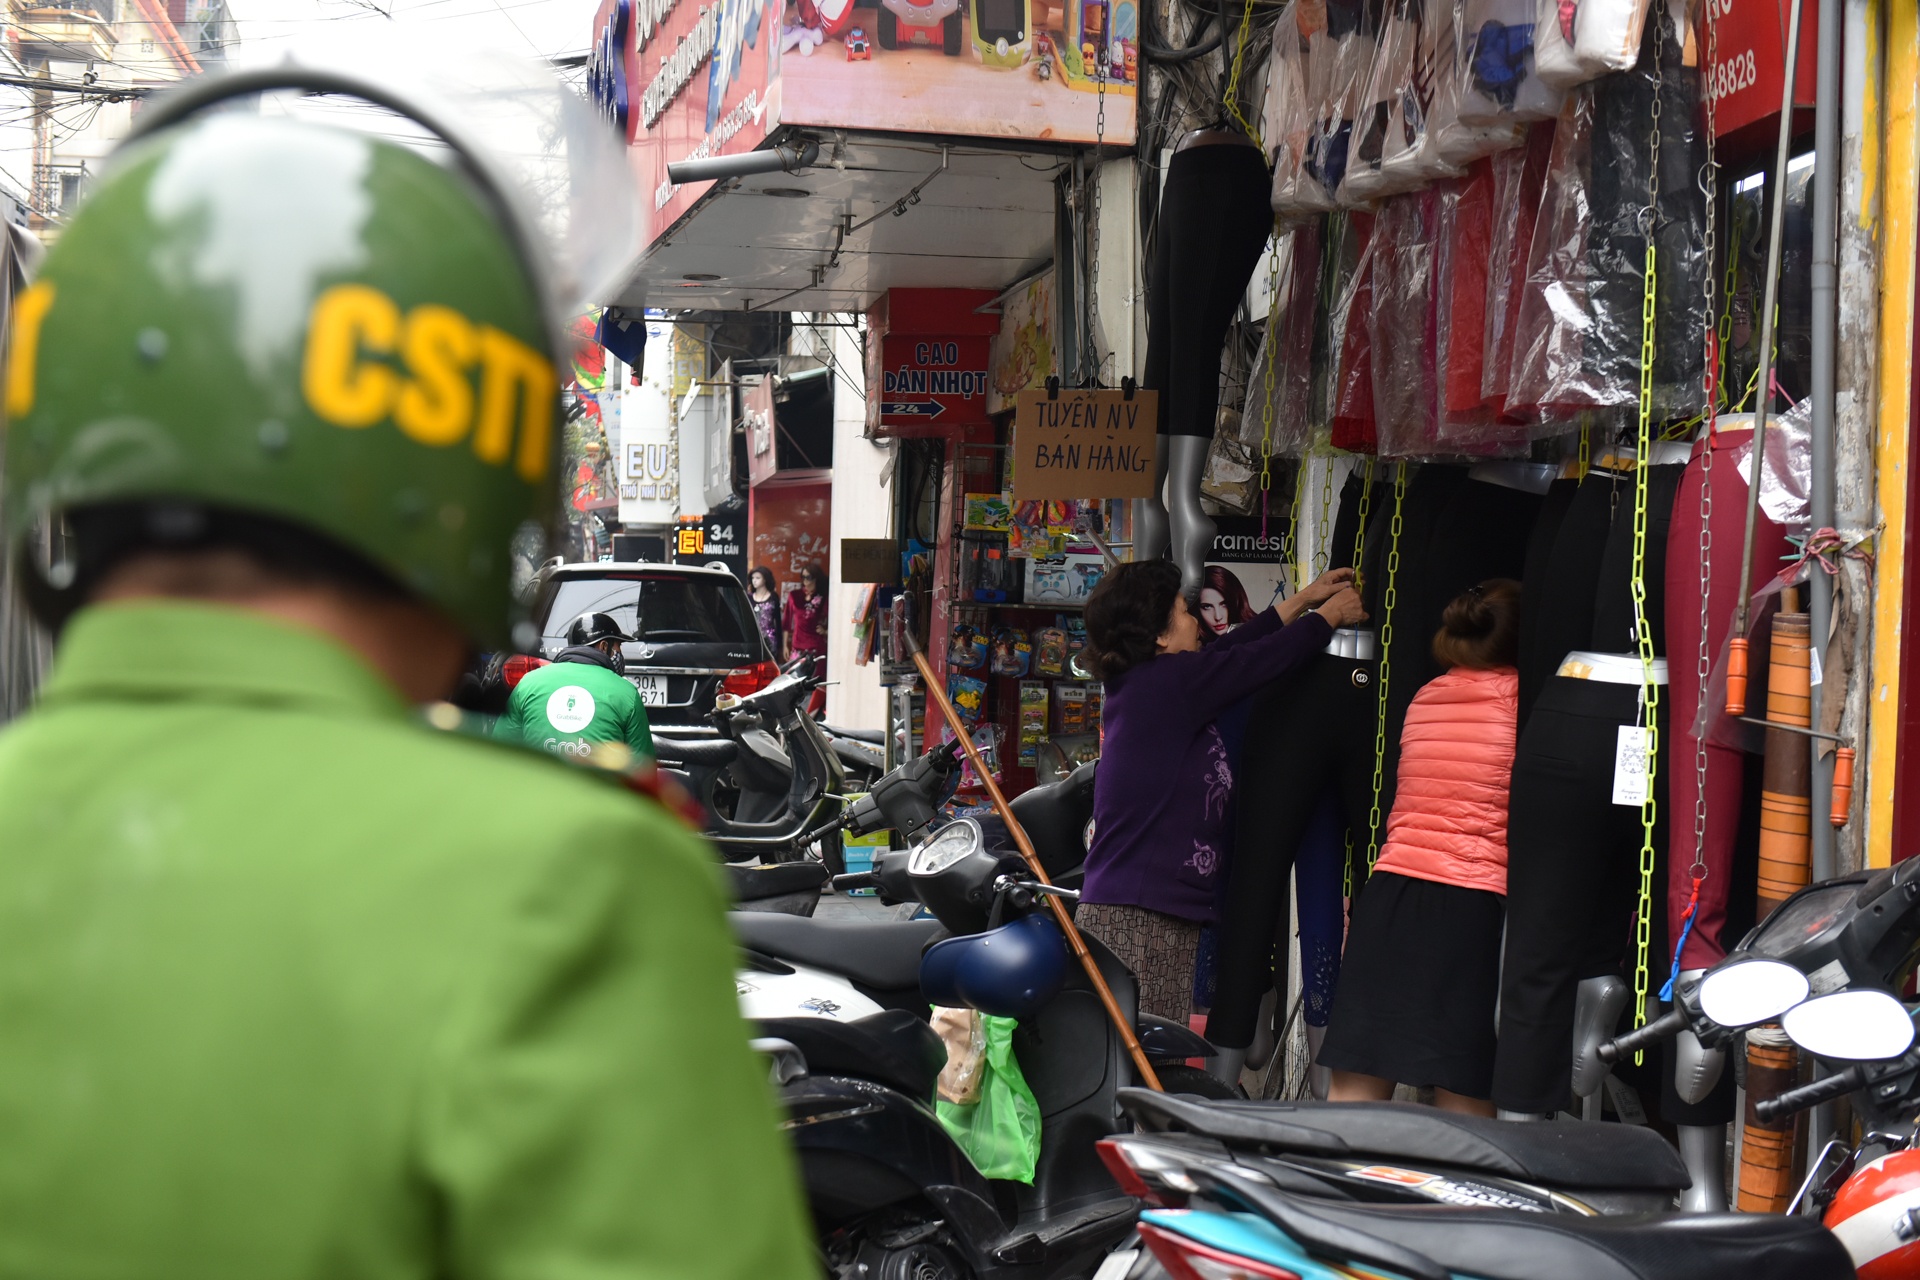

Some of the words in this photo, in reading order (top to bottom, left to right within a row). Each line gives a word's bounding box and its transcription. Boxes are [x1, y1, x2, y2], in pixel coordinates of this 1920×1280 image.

[915, 342, 958, 366] CAO
[677, 361, 703, 377] EU
[884, 364, 927, 394] DÁN
[929, 370, 987, 400] NHỌT
[892, 404, 919, 414] 24
[1107, 402, 1139, 429] NV
[626, 443, 668, 480] EU
[1035, 433, 1081, 470] BÁN
[1087, 434, 1151, 473] HÀNG
[710, 524, 734, 541] 34
[703, 541, 723, 555] HÀNG
[634, 676, 656, 690] 30A
[641, 691, 665, 704] 6.71
[556, 713, 582, 721] GrabBike
[544, 737, 591, 757] Grab
